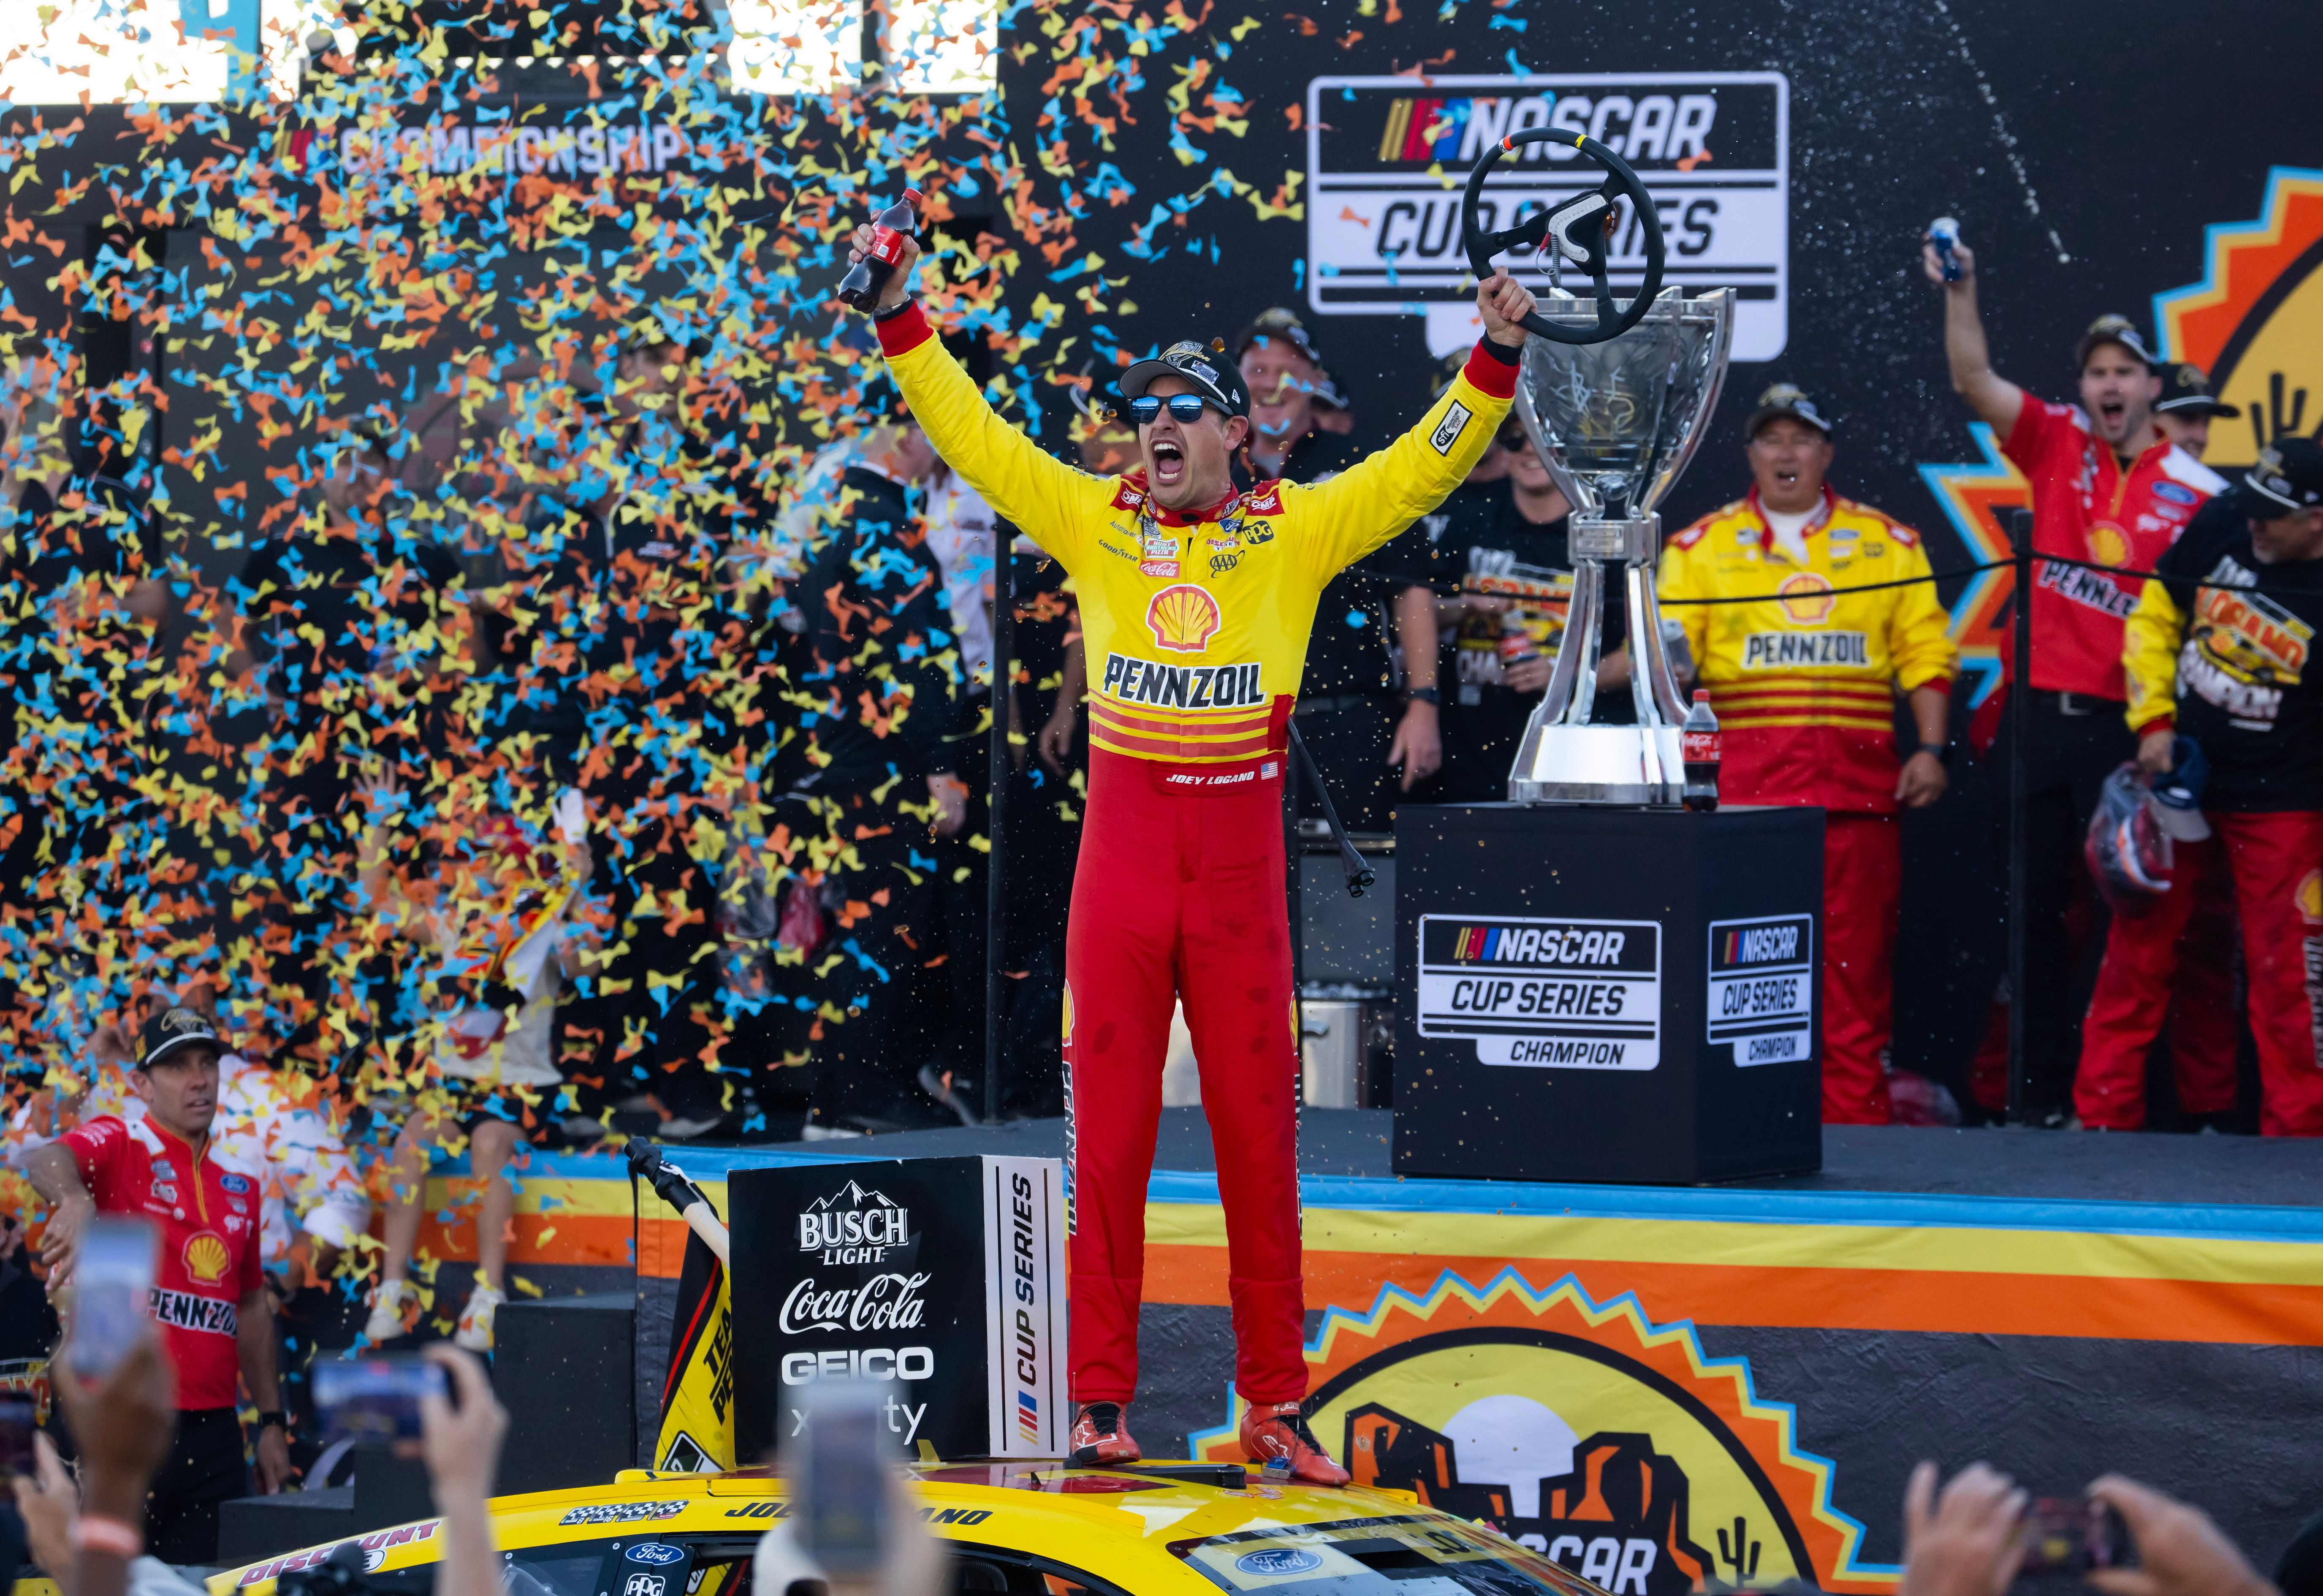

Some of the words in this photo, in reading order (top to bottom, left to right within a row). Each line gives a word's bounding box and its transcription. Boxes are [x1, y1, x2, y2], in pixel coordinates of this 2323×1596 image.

[1459, 95, 1718, 161] NASCAR
[340, 126, 681, 173] CAMPIONSHIP
[1438, 430, 1449, 444] sfi
[1251, 497, 1275, 509] OMP
[1244, 524, 1272, 543] PPG
[1140, 562, 1179, 576] Coca-Cola
[1212, 555, 1236, 571] AAA
[1742, 631, 1871, 669] PENNZOIL
[1102, 651, 1267, 710] PENNZOIL
[1166, 774, 1205, 785] JOEY
[1206, 771, 1255, 784] LOGANO
[1495, 928, 1625, 965] NASCAR
[1742, 926, 1799, 963] NASCAR
[1451, 980, 1514, 1013] CUP
[1517, 983, 1628, 1016] SERIES
[1722, 983, 1750, 1016] CUP
[1752, 978, 1798, 1012] SERIES
[1510, 1040, 1626, 1066] CHAMPION
[1748, 1035, 1797, 1062] CHAMPION
[799, 1207, 909, 1251] BUSCH
[1012, 1172, 1034, 1306] SERIES
[823, 1246, 885, 1265] LIGHT
[147, 1286, 237, 1338] PENNZO
[779, 1272, 931, 1335] Coca-Cola
[703, 1295, 732, 1379] TEA
[1015, 1310, 1037, 1387] CUP
[782, 1346, 934, 1386] GEICO
[712, 1355, 733, 1427] PE
[238, 1520, 442, 1588] DISCUNT
[636, 1545, 673, 1562] Ford
[1252, 1553, 1309, 1572] Ford
[627, 1577, 662, 1596] PPG
